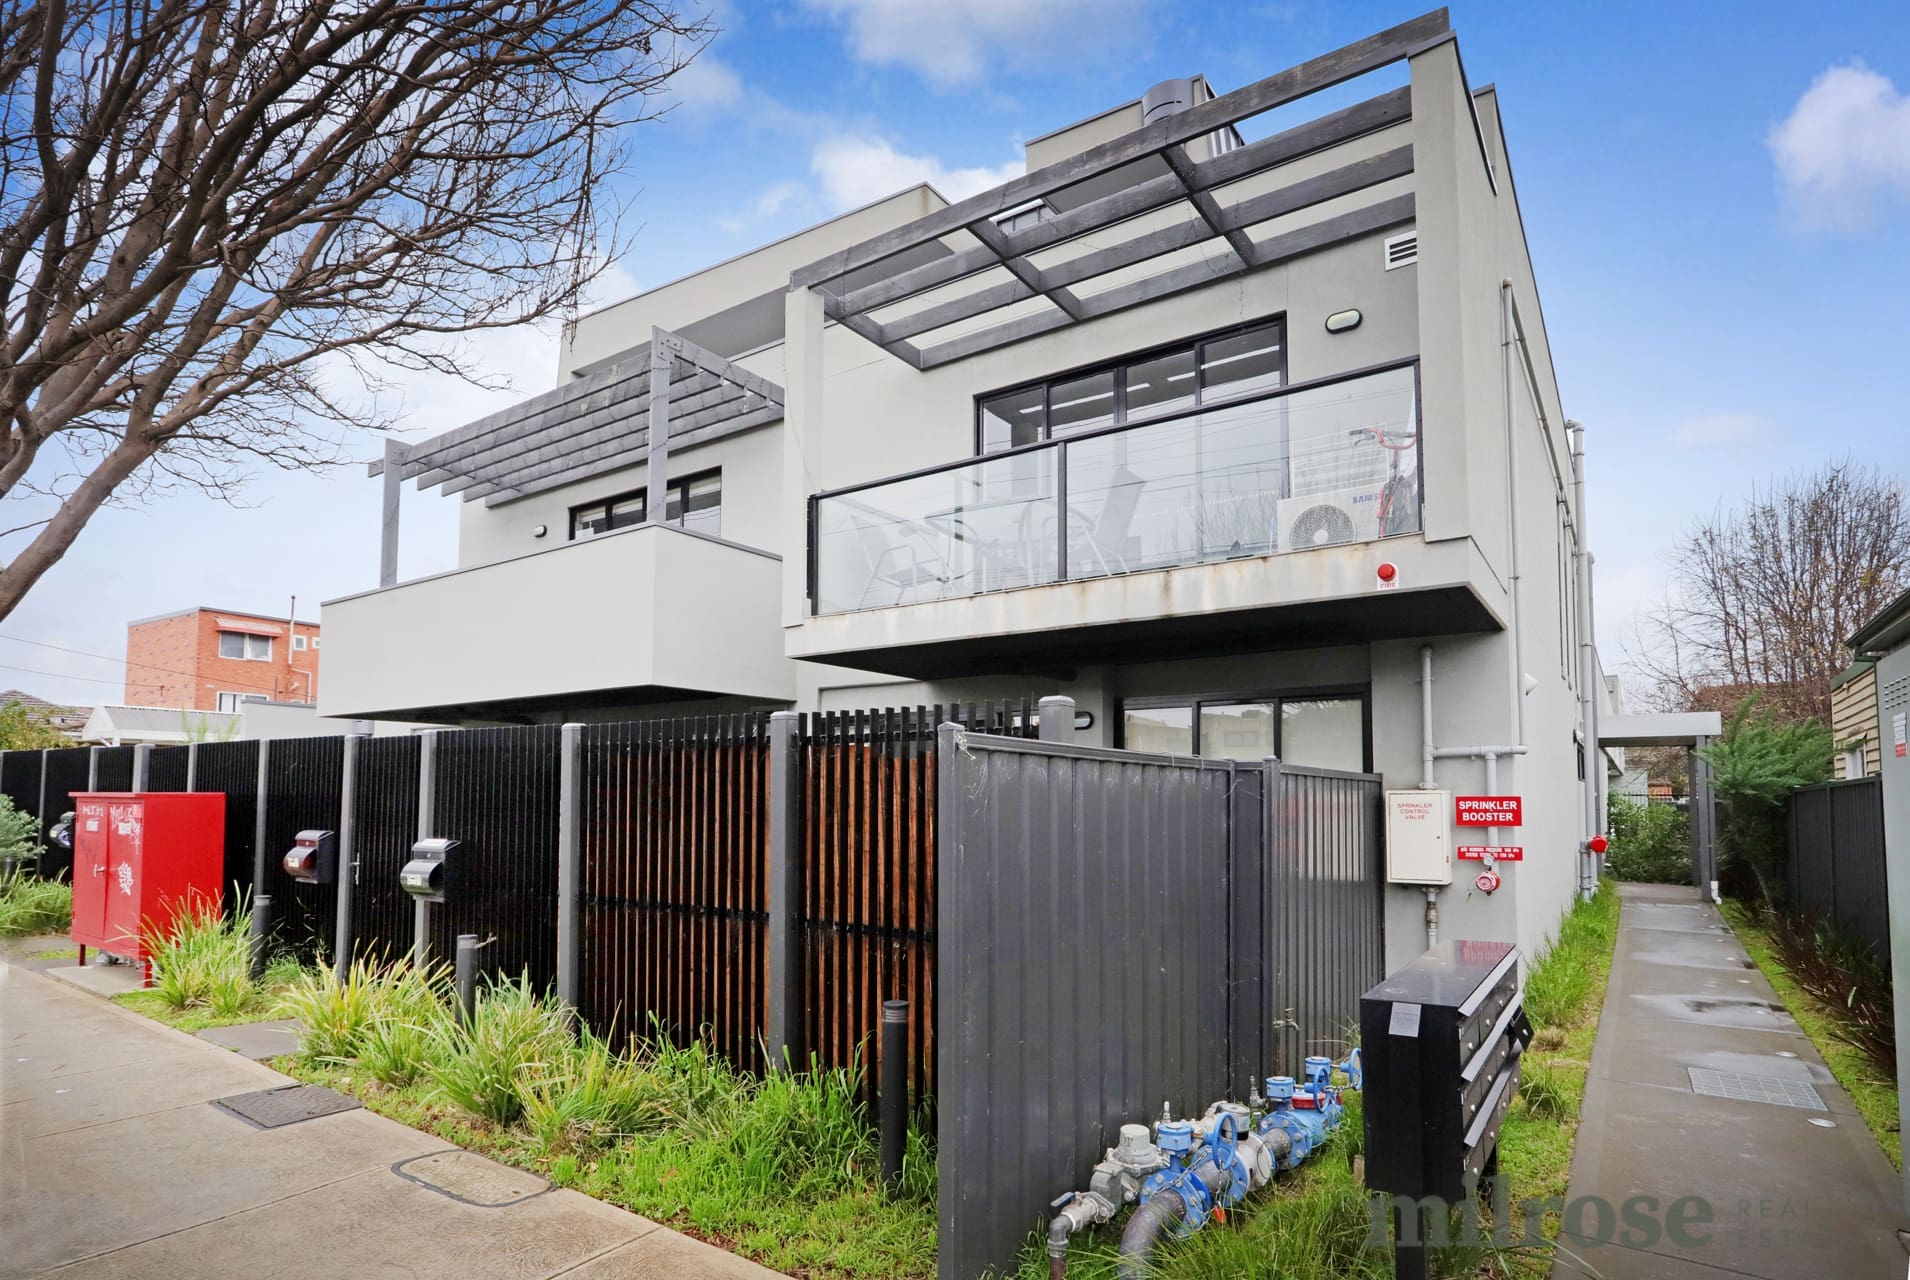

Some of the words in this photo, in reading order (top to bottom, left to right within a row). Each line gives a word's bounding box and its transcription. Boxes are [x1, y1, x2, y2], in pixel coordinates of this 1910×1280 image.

[1352, 494, 1379, 504] SAMS
[1380, 582, 1396, 590] FIRE
[1459, 801, 1517, 810] SPRINKLER
[1463, 812, 1513, 821] BOOSTER
